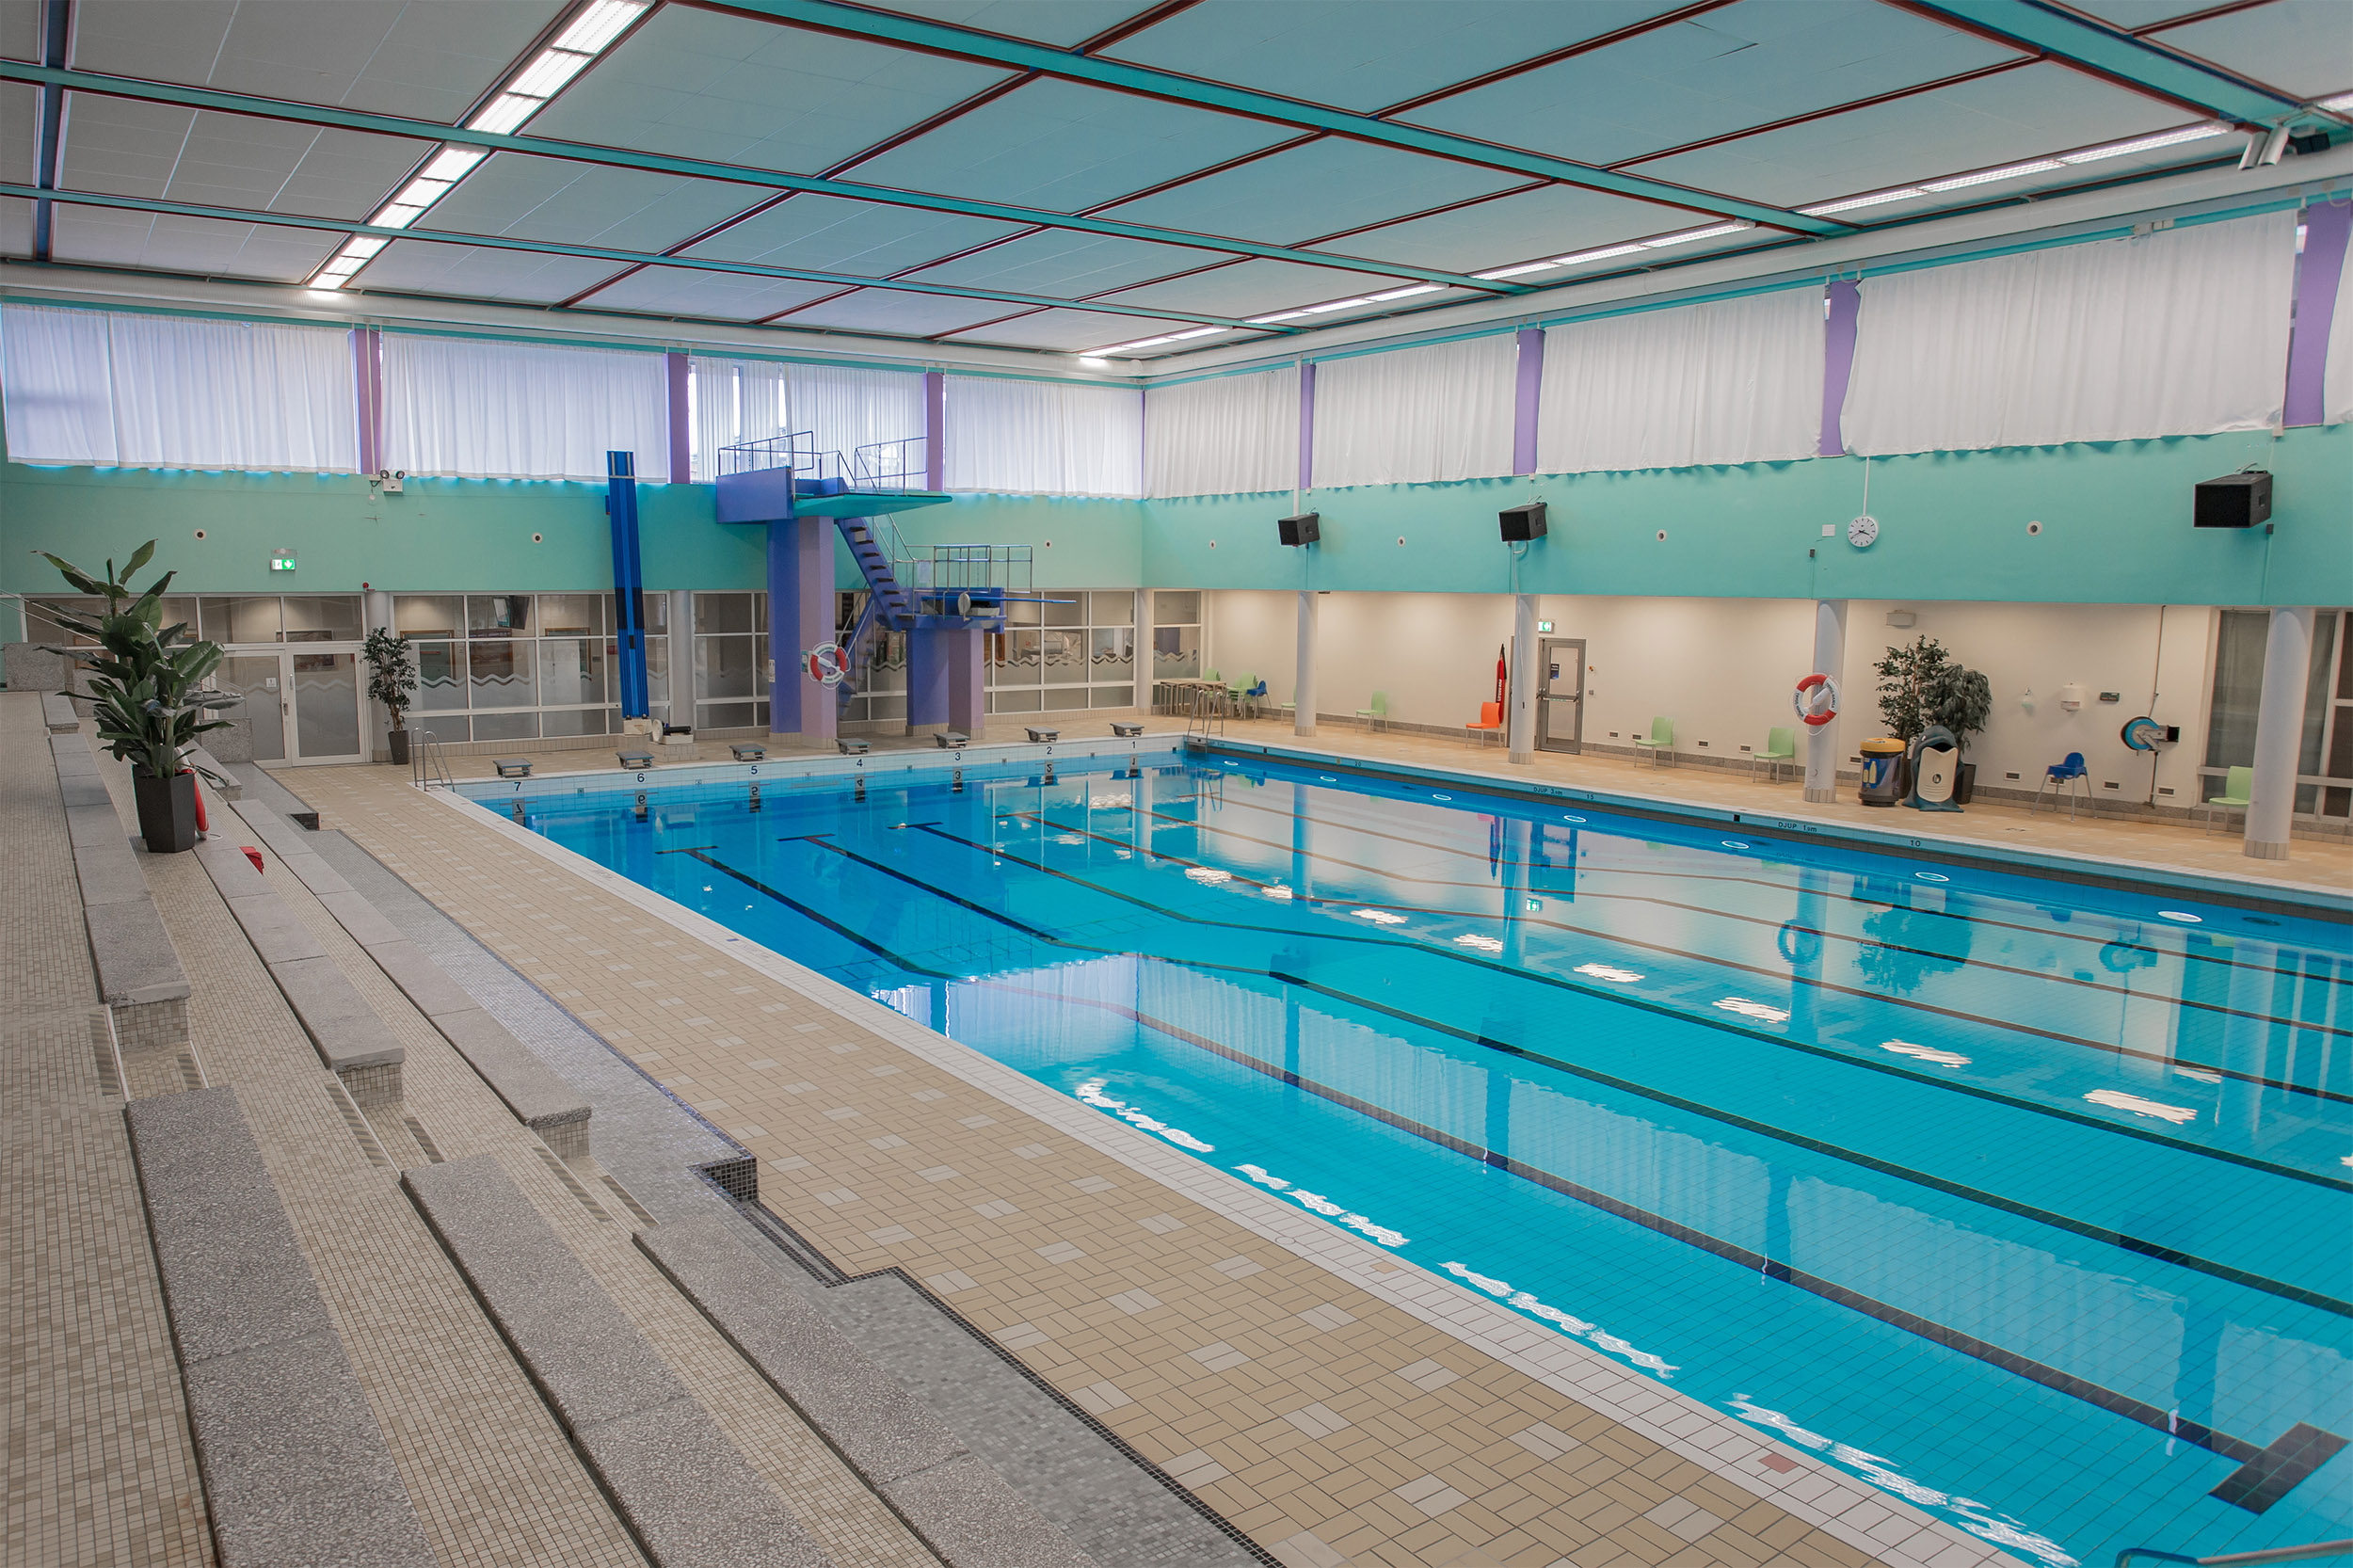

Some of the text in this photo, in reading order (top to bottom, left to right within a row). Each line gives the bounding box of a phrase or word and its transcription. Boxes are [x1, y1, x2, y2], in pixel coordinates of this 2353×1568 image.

[1131, 741, 1136, 749] 1
[1047, 746, 1052, 755] 2
[954, 752, 961, 761] 3
[856, 759, 863, 767] 4
[750, 765, 758, 776] 5
[636, 773, 645, 783] 6
[514, 781, 521, 792] 7
[1533, 786, 1548, 794] DJUP
[1778, 821, 1798, 830] DJUP
